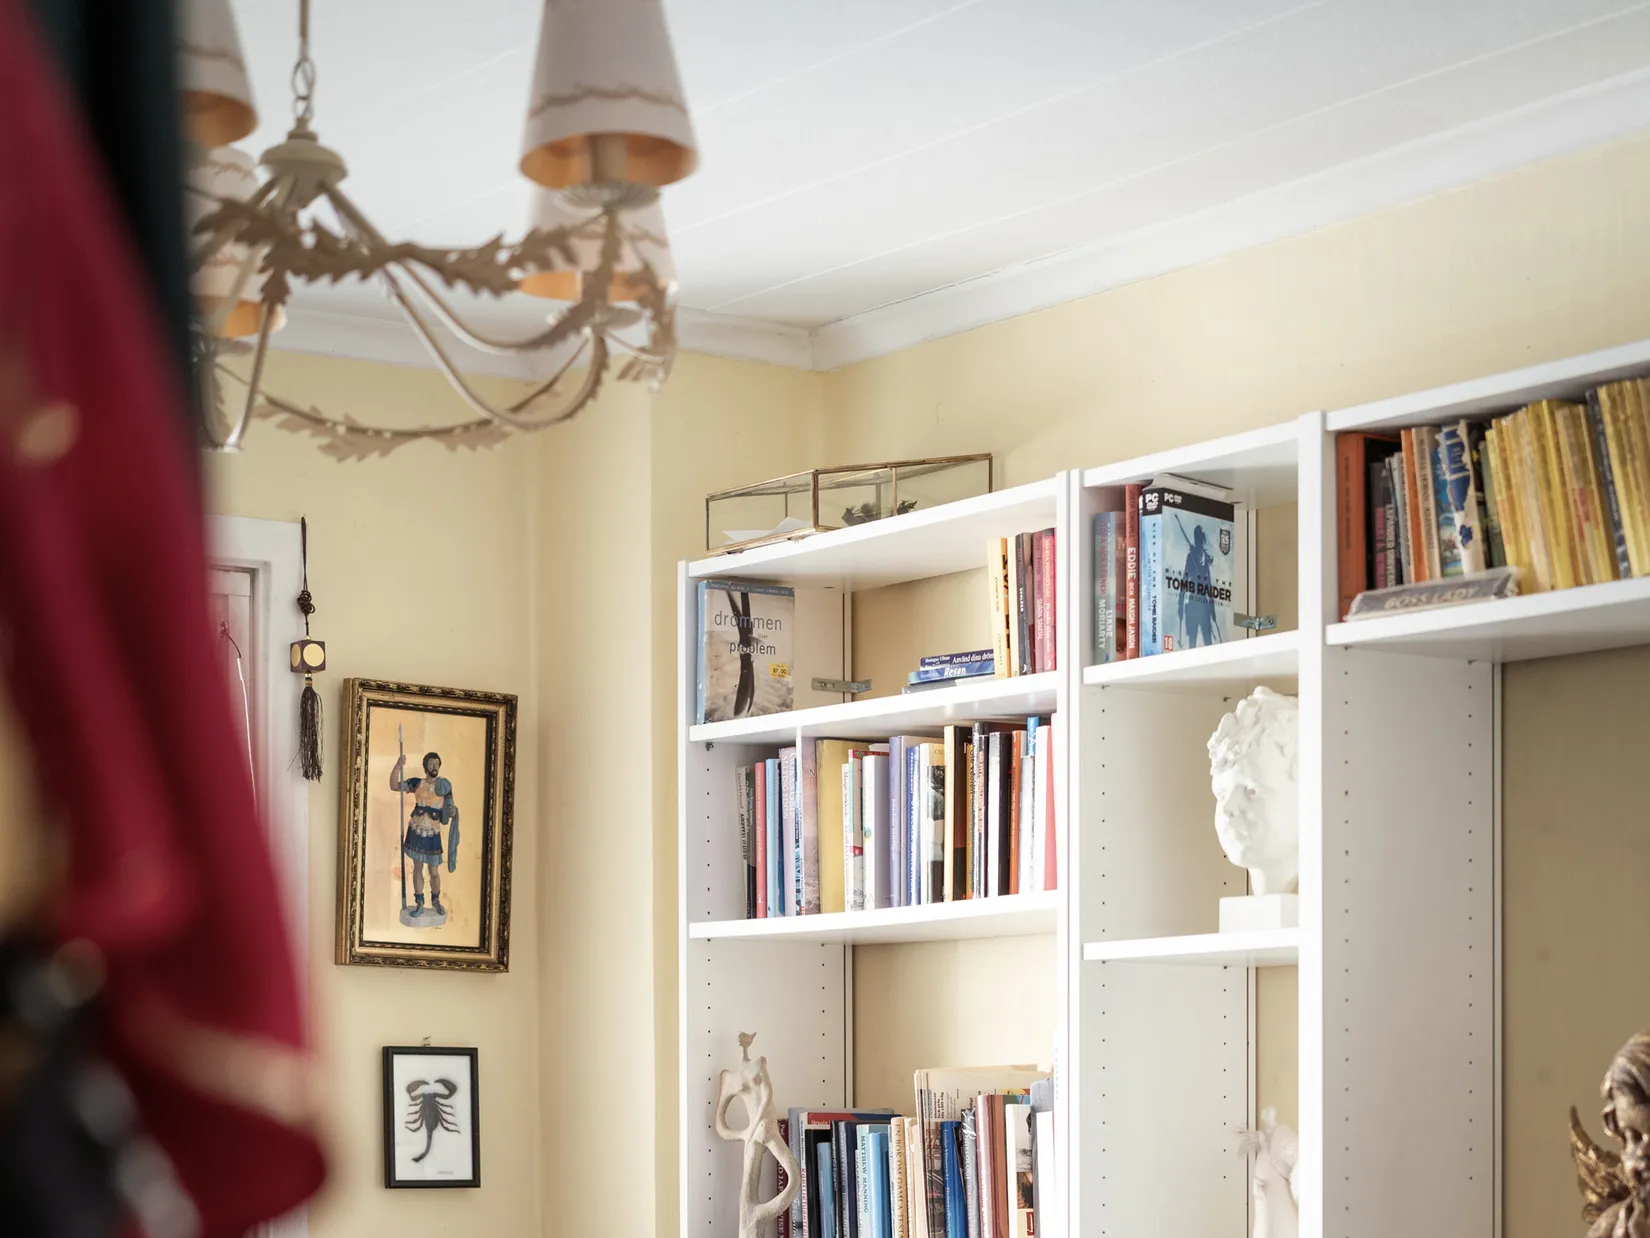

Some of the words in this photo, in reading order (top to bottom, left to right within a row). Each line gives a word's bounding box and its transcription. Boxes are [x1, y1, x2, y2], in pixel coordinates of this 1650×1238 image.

[1145, 493, 1158, 502] PC
[1164, 492, 1174, 502] PC
[1128, 547, 1136, 580] EDDIE
[1386, 550, 1395, 588] UNIVERS
[1166, 576, 1196, 593] TOMB
[1196, 582, 1232, 602] RAIDER
[1384, 592, 1430, 610] BOSS
[1432, 586, 1480, 604] LADY
[1128, 598, 1136, 624] MAXON
[714, 610, 782, 631] drömmen
[1098, 598, 1106, 649] MORIARTY
[1128, 625, 1136, 649] JAXON
[1164, 636, 1173, 650] 18
[729, 642, 776, 656] problem
[952, 654, 970, 664] Använd
[971, 654, 981, 662] dina
[944, 667, 966, 678] Resan
[894, 1124, 901, 1137] EN
[896, 1160, 902, 1175] OM
